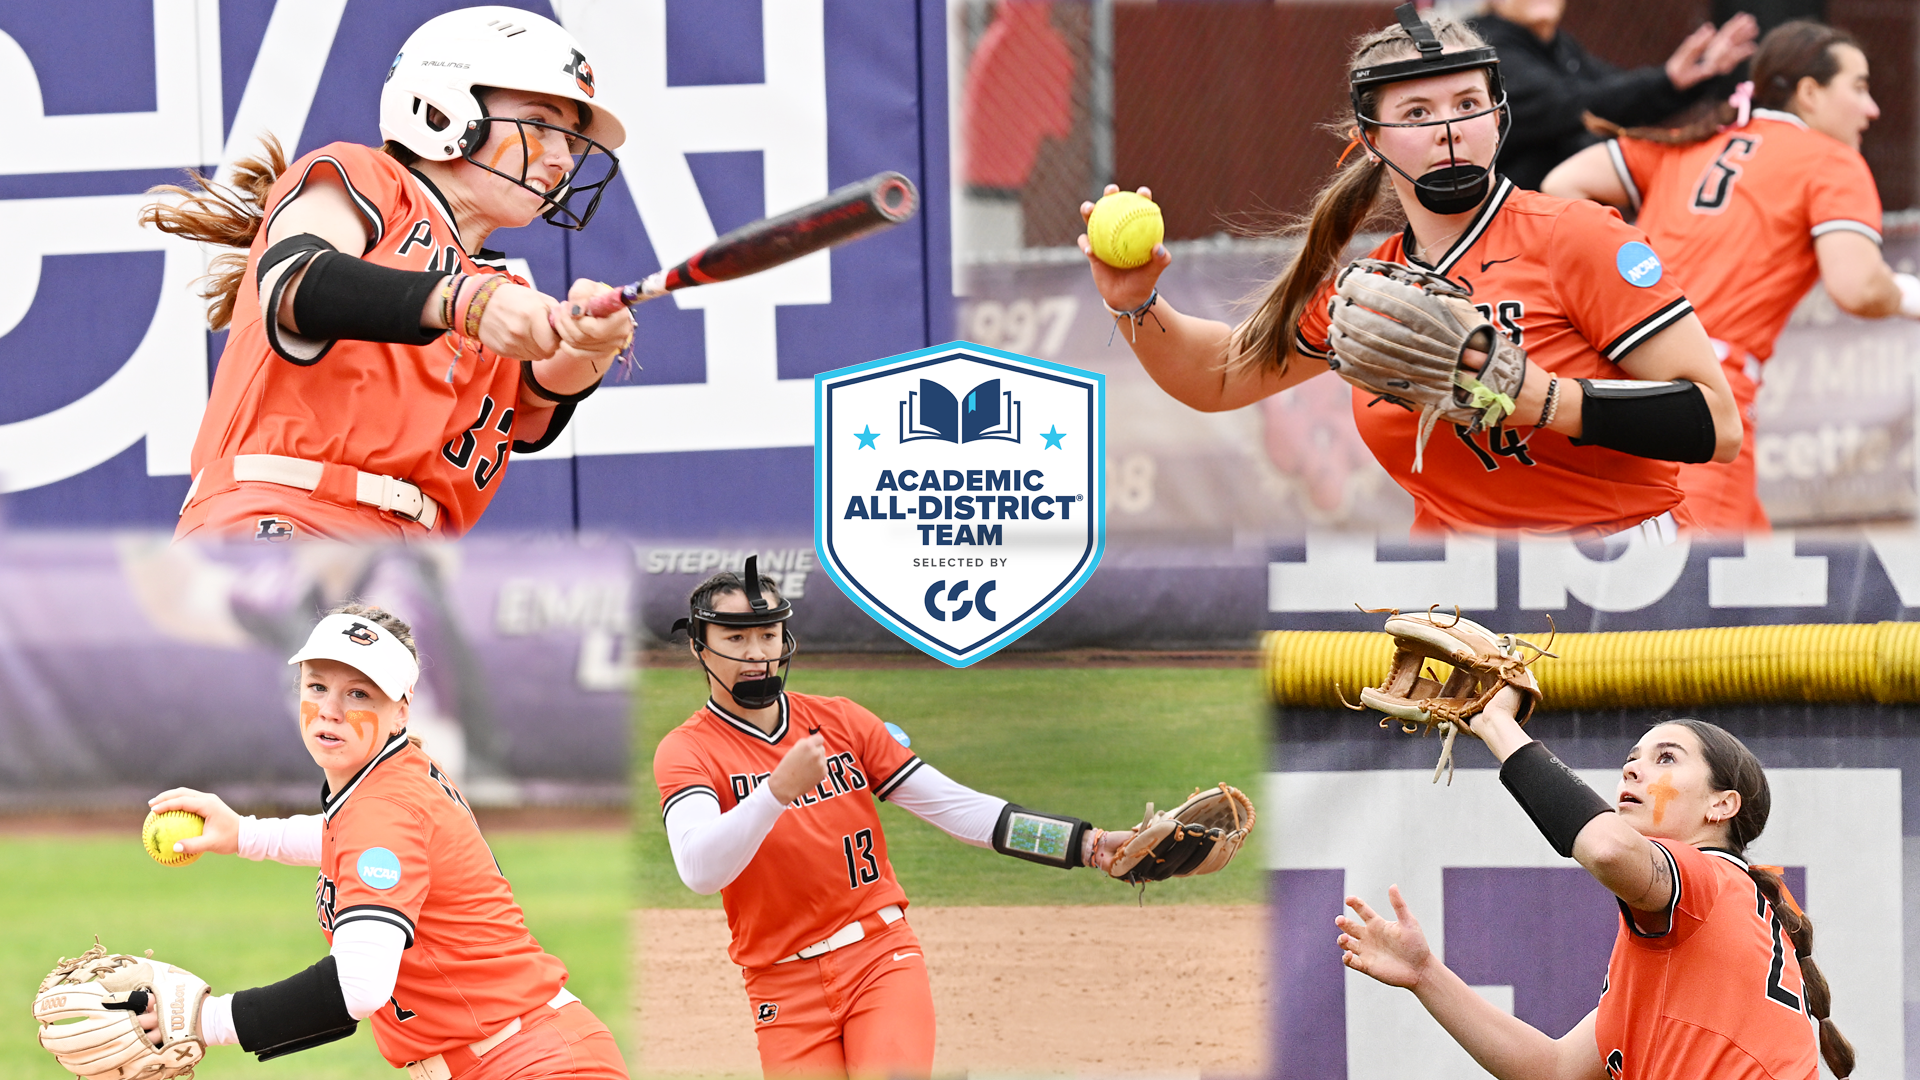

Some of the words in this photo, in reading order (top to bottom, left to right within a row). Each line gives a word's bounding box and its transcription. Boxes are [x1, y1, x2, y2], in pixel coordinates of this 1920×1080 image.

[420, 60, 471, 69] RAWLINGS
[1627, 256, 1660, 281] NCAA
[729, 750, 868, 809] PERS
[842, 827, 881, 889] 13
[362, 865, 398, 882] NCAA
[39, 995, 68, 1013] A2000
[170, 983, 186, 1032] Wilson
